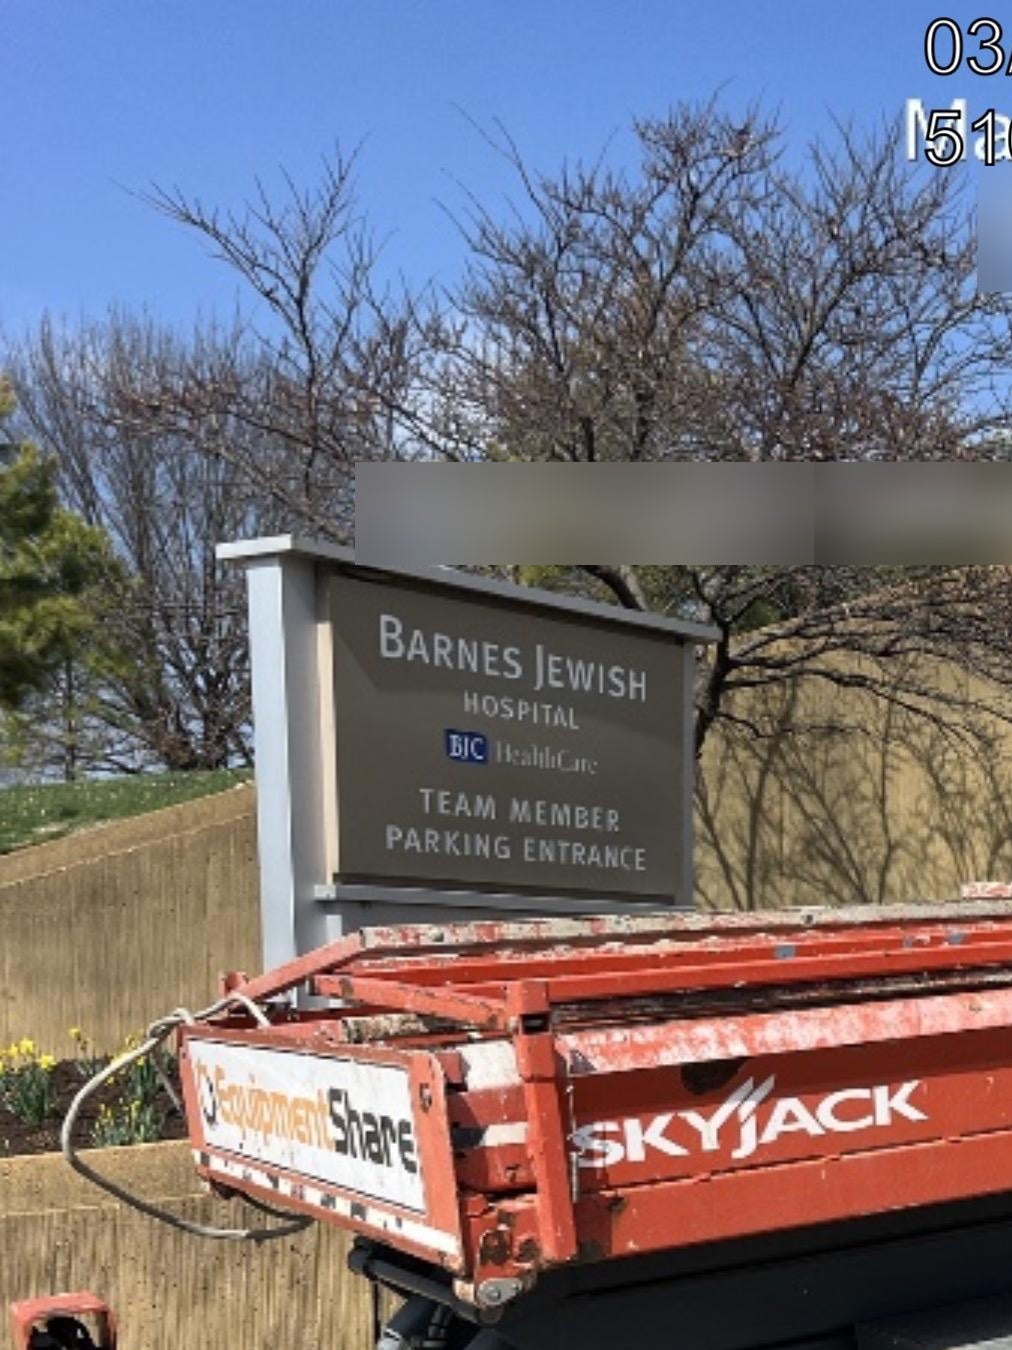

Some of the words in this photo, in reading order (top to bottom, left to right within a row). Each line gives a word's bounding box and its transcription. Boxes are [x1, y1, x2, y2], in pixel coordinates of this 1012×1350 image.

[378, 614, 523, 680] BARNES
[534, 644, 648, 702] JEWISH
[464, 691, 580, 731] HOSPITAL
[449, 734, 485, 761] BJC
[496, 741, 599, 775] HealthCare
[419, 788, 497, 820] TEAM
[509, 797, 621, 833] MEMBER
[385, 825, 512, 860] PARKING
[523, 837, 647, 871] ENTRANCE
[571, 1074, 928, 1168] SKYJACK
